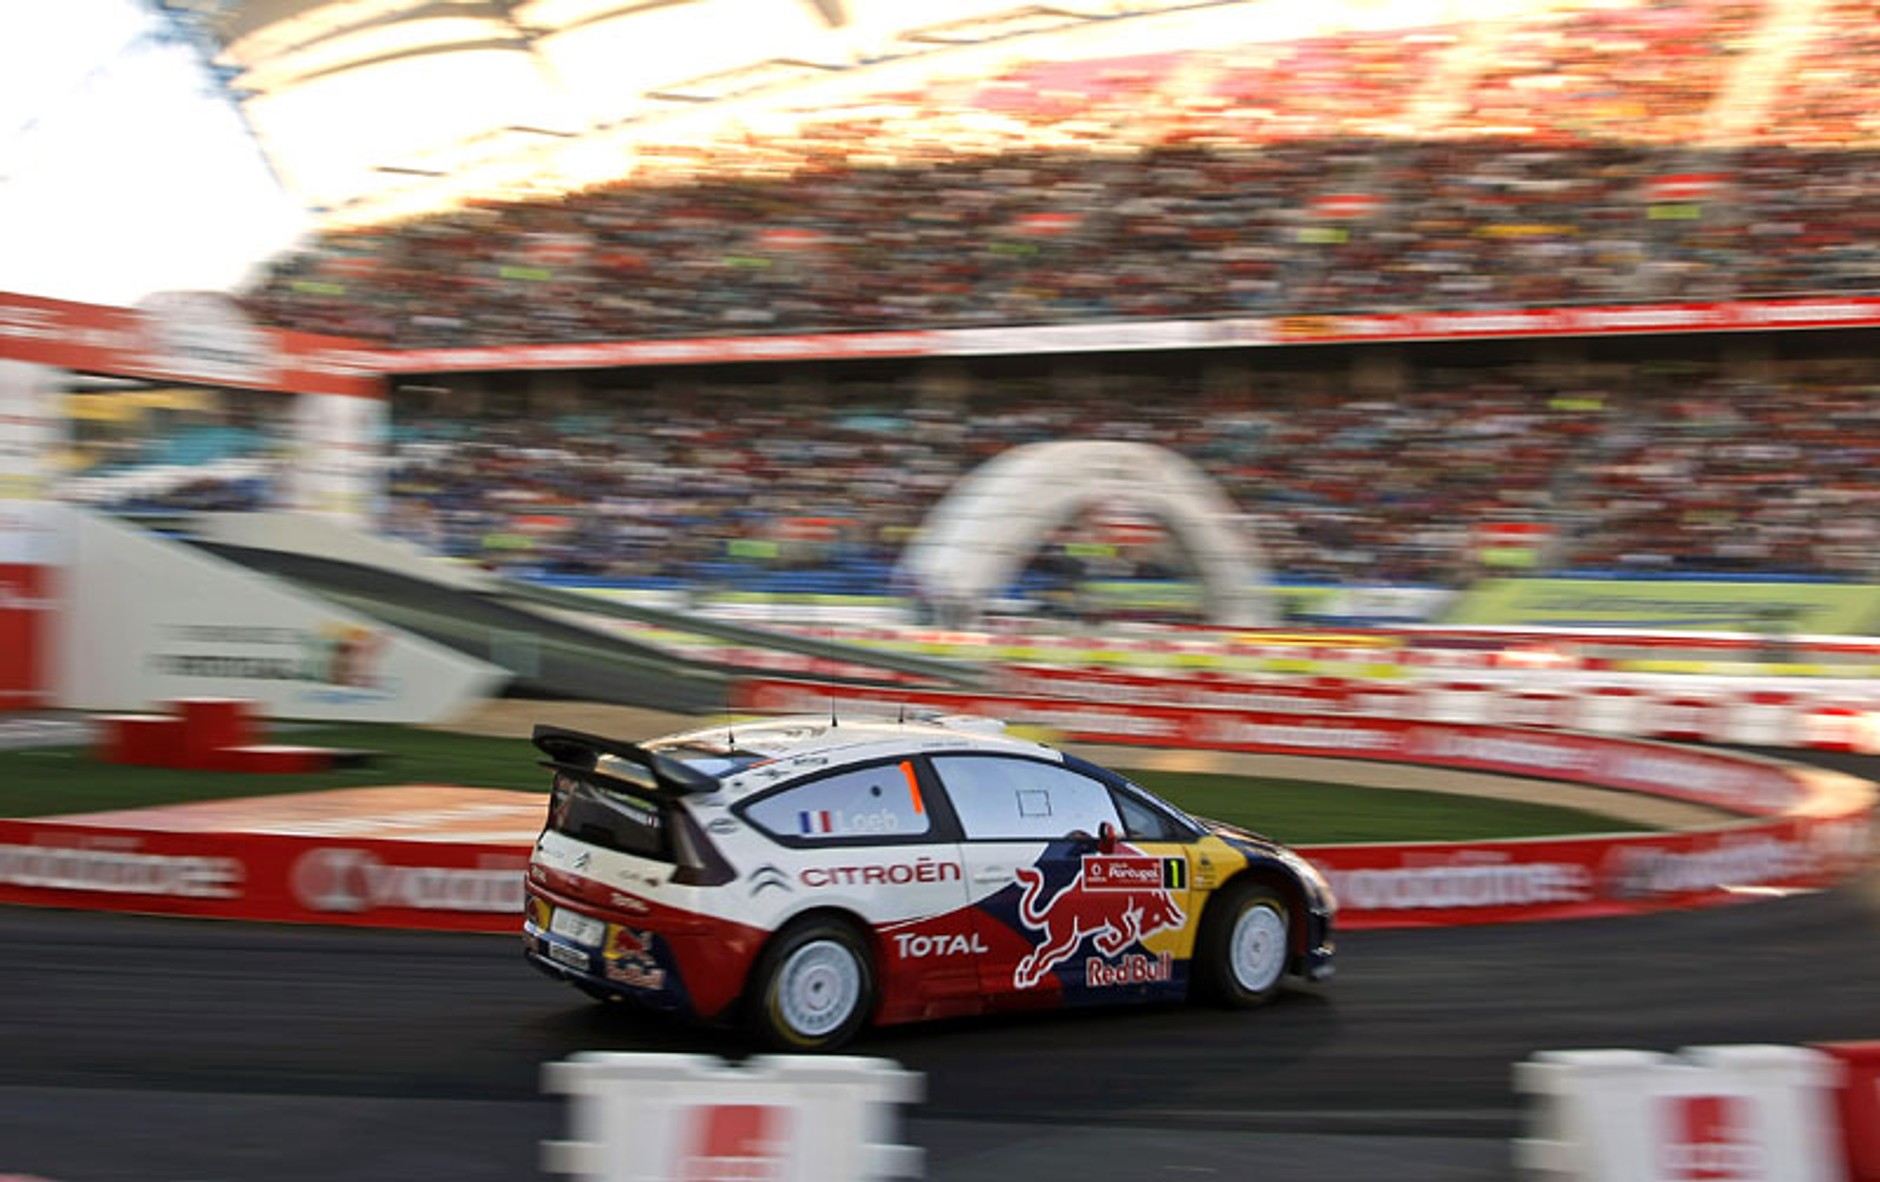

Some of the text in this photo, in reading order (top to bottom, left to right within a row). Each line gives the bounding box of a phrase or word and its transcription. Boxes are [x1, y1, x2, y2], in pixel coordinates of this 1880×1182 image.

[899, 761, 922, 814] 1
[837, 808, 897, 832] Loeb
[1109, 866, 1159, 880] Portugal
[1169, 859, 1179, 887] 1
[893, 932, 989, 959] TOTAL
[1086, 950, 1172, 987] Red Bull
